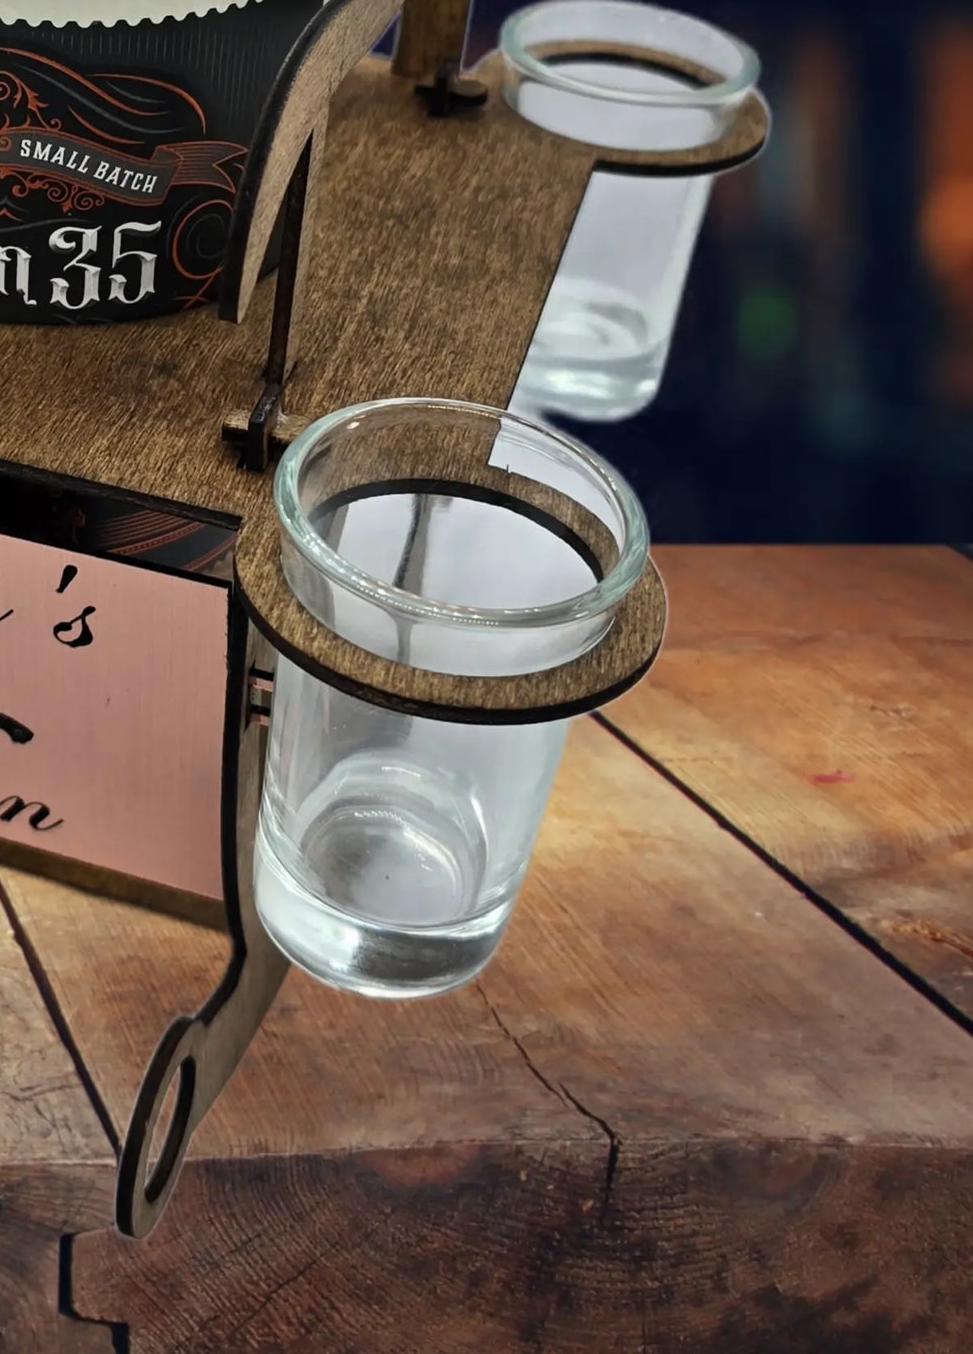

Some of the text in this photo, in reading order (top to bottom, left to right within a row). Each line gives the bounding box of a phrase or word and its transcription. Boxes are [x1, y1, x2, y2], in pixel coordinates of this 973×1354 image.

[20, 139, 158, 193] SMALL BATCH
[49, 220, 162, 309] 35
